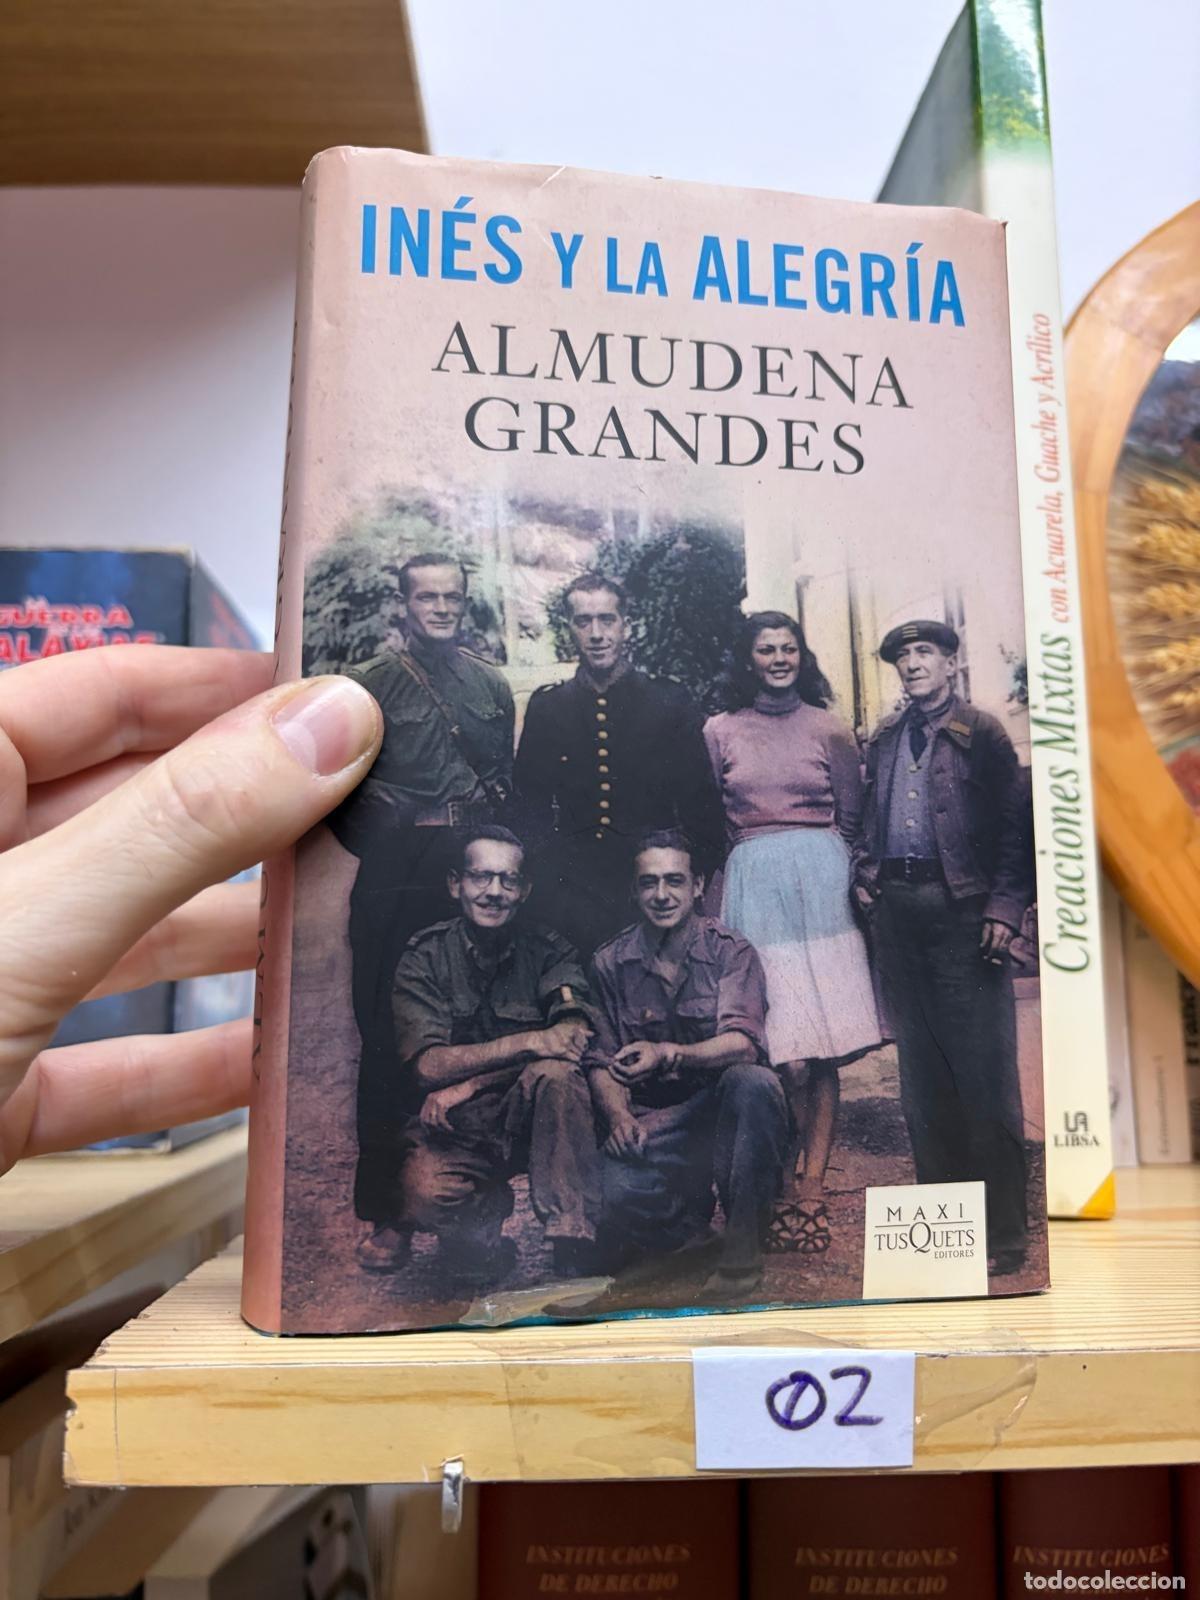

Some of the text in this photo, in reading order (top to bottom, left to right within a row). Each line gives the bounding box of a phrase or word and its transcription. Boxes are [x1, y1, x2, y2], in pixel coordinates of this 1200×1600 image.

[361, 195, 966, 327] INÉS Y LA ALEGRÍA
[431, 320, 914, 409] ALMUDENA
[464, 397, 867, 476] GRANDES
[1024, 312, 1090, 973] Creaciones Mixtas con Acuarela, Guache y Acrílico
[1053, 1134, 1099, 1147] LIBSA
[887, 1203, 963, 1222] MAXI
[934, 1249, 974, 1259] EDITORES
[765, 1366, 884, 1431] 02
[526, 1544, 691, 1565] INSTITUCIONES
[795, 1547, 958, 1567] INSTITUCIONES
[1012, 1543, 1169, 1567] INSTITUCIONES
[539, 1573, 679, 1593] DE DERECHO
[809, 1576, 947, 1595] DE DERECHO
